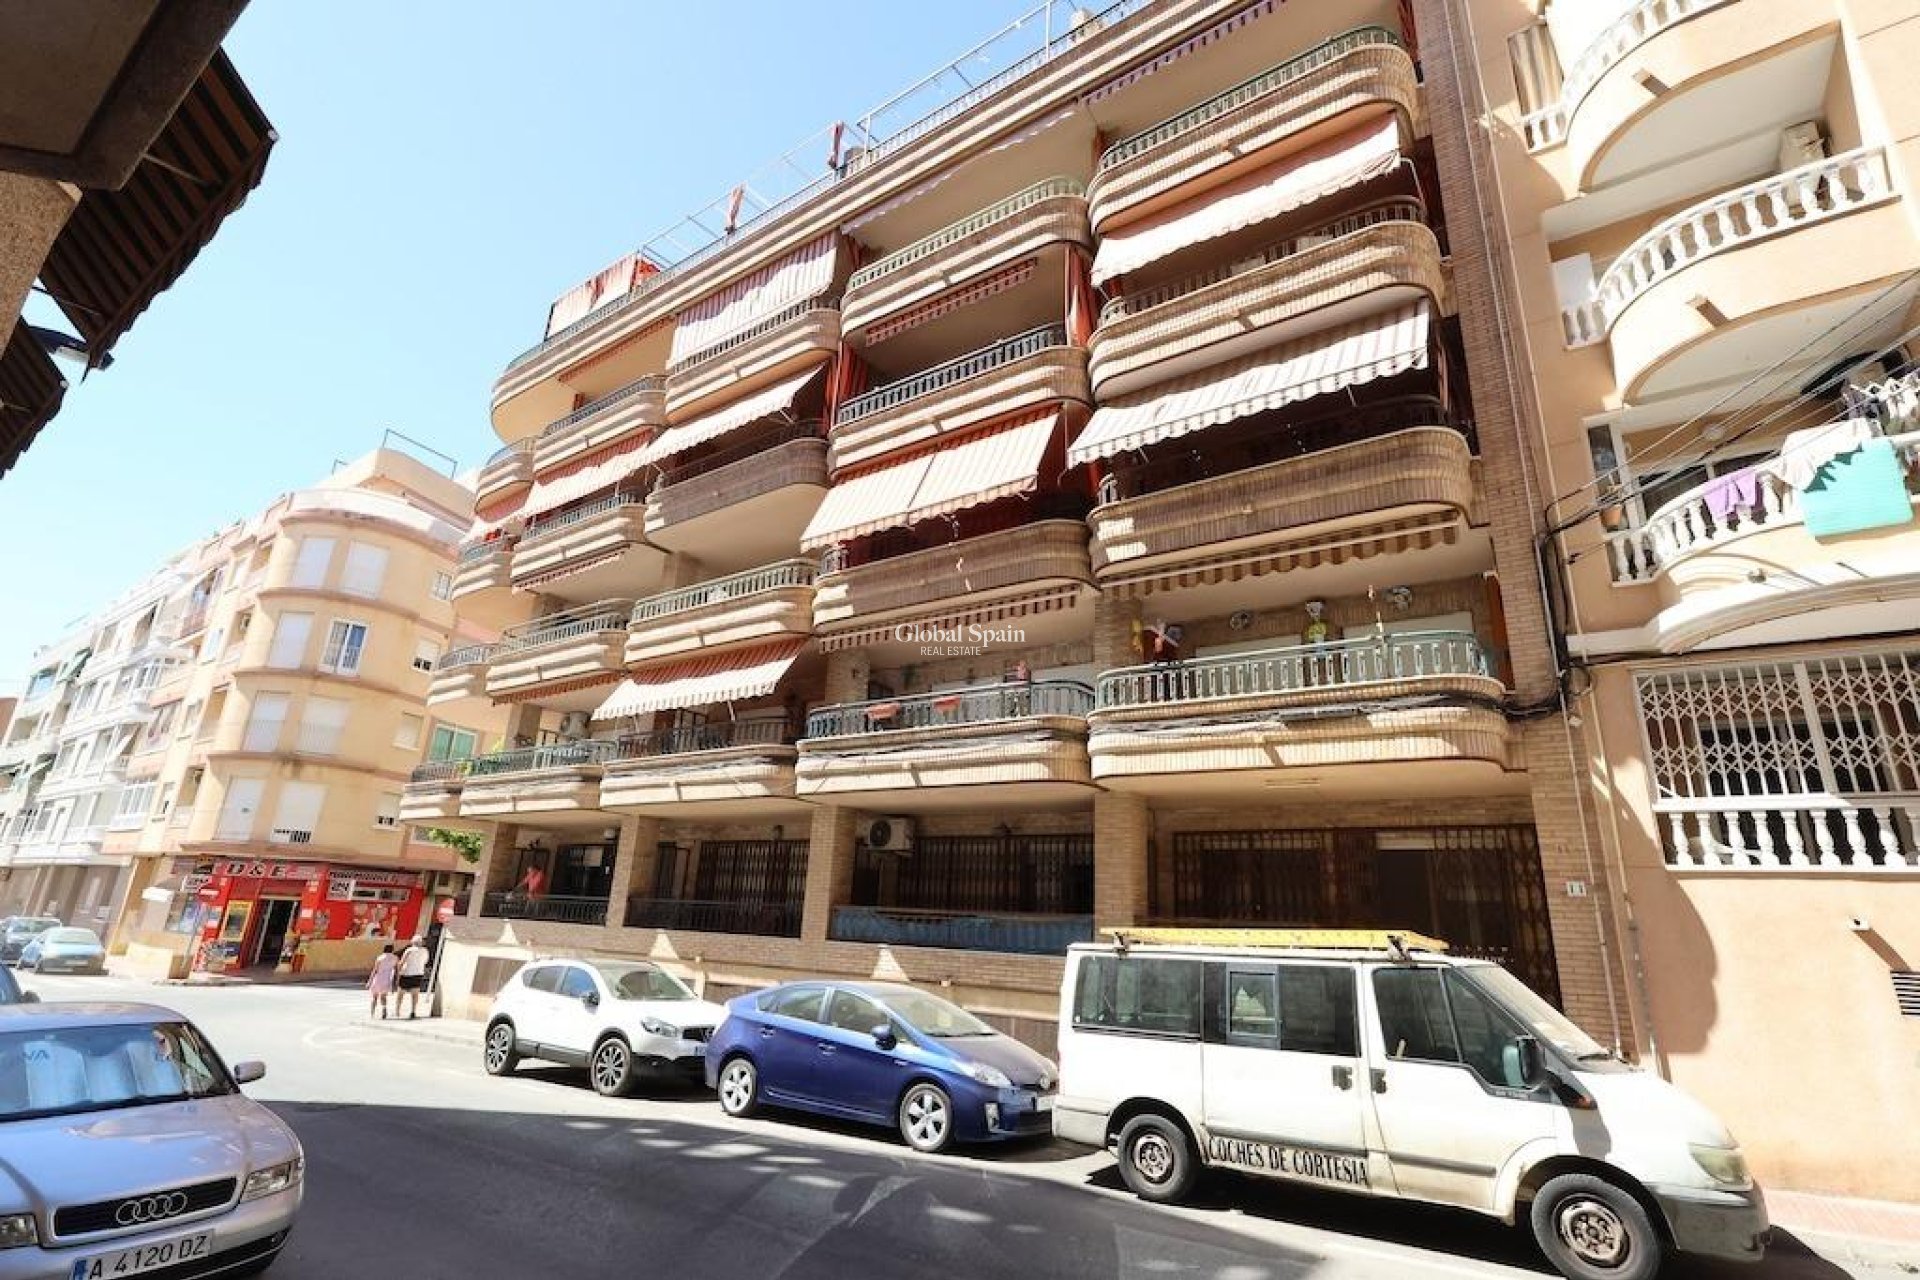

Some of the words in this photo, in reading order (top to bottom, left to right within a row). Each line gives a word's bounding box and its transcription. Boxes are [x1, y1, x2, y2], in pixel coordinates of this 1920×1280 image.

[1208, 1135, 1265, 1168] COCHES
[1268, 1145, 1290, 1173] DE
[1293, 1149, 1369, 1186] CORTESIA
[89, 1258, 103, 1280] A
[114, 1243, 174, 1273] 4120
[178, 1235, 207, 1259] DZ
